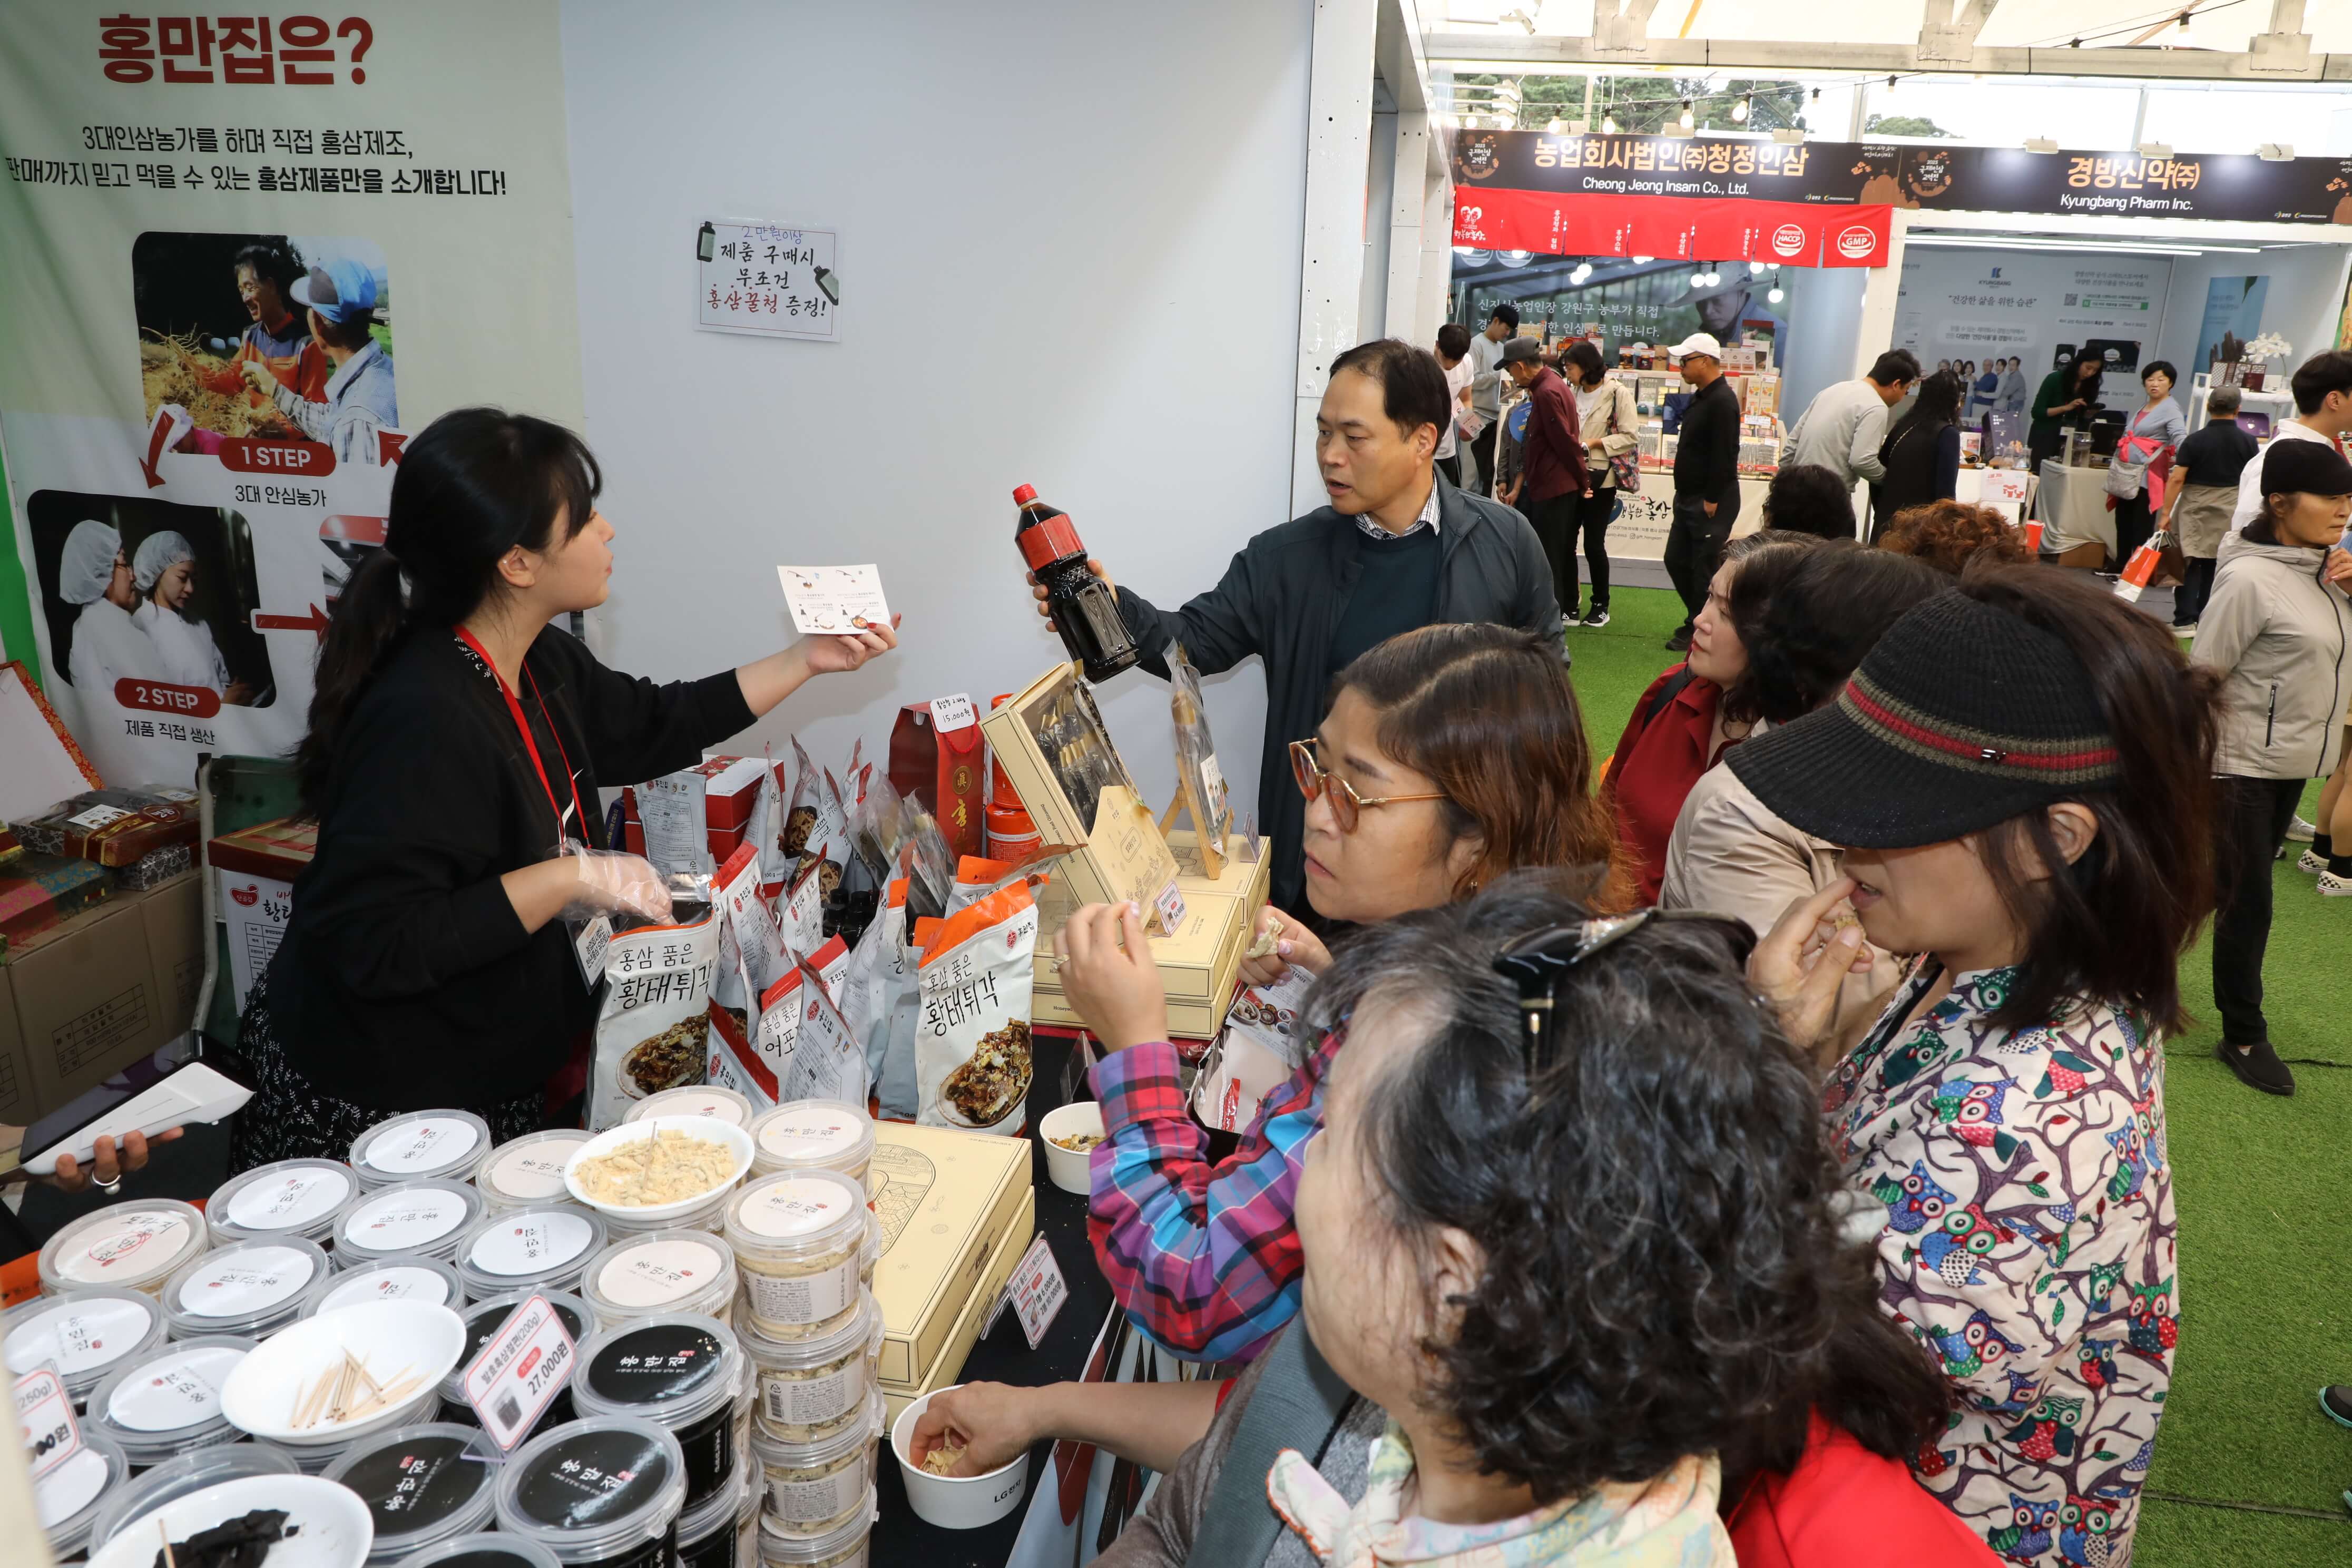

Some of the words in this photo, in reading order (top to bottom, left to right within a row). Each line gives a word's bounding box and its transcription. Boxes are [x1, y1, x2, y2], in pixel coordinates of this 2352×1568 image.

[99, 14, 374, 85] 홍만집은?
[82, 126, 219, 153] 3대인삼농가를
[225, 128, 264, 153] 하며
[272, 129, 313, 154] 직접
[321, 130, 413, 159] 홍삼제조,
[92, 162, 131, 187] 믿고
[136, 164, 177, 189] 먹을
[183, 165, 204, 190] 수
[211, 165, 250, 191] 있는
[258, 165, 384, 194] 홍삼제품만을
[391, 169, 506, 195] 소개합니다!
[1582, 177, 1626, 194] Cheong
[1628, 179, 1663, 195] Jeong
[1665, 181, 1700, 193] Insam
[1702, 182, 1726, 195] Co.,
[1728, 183, 1749, 195] Ltd.
[2060, 193, 2128, 212] Kyungbang
[2129, 195, 2170, 210] Pharm
[2172, 197, 2194, 210] Inc.
[721, 241, 755, 263] 제품
[763, 245, 814, 266] 구매시
[1846, 237, 1868, 246] GMP
[736, 268, 790, 289] 무조건
[707, 289, 778, 314] 홍삼꿀청
[786, 295, 827, 317] 증정!
[1561, 302, 1595, 315] 강원구
[1598, 303, 1632, 317] 농부가
[1636, 305, 1659, 318] 직접
[1978, 296, 1996, 306] 삶을
[1997, 297, 2014, 307] 위한
[1563, 321, 1608, 335] 인심로
[1612, 325, 1660, 338] 만듭니다.
[241, 446, 251, 464] 1
[256, 447, 311, 467] STEP
[234, 485, 261, 504] 3대
[265, 486, 327, 507] 안심농가
[1644, 496, 1672, 522] 홍삼
[135, 686, 145, 702] 2
[152, 688, 199, 710] STEP
[942, 708, 972, 723] 15,000원
[125, 718, 154, 738] 제품
[159, 722, 186, 741] 직접
[190, 726, 215, 746] 생산
[1017, 921, 1034, 937] 홍만집
[619, 947, 654, 972] 홍삼
[662, 943, 693, 966] 품은
[618, 959, 712, 1010] 황태튀각
[928, 969, 948, 994] 홍삼
[952, 953, 973, 980] 품은
[924, 971, 998, 1037] 황태튀각
[763, 1012, 781, 1034] 홍삼
[781, 1003, 798, 1023] 품은
[819, 1010, 834, 1034] 홍만집
[720, 1065, 737, 1090] 홍만집
[635, 1261, 683, 1281] 홍만집
[1041, 1272, 1056, 1296] 6,000원
[1046, 1280, 1062, 1306] 10,000원
[527, 1340, 569, 1396] 27,000원
[620, 1355, 687, 1368] 홍만집
[385, 1459, 427, 1512] 홍만집
[560, 1459, 624, 1489] 홍만집
[994, 1478, 1021, 1503] LG전자
